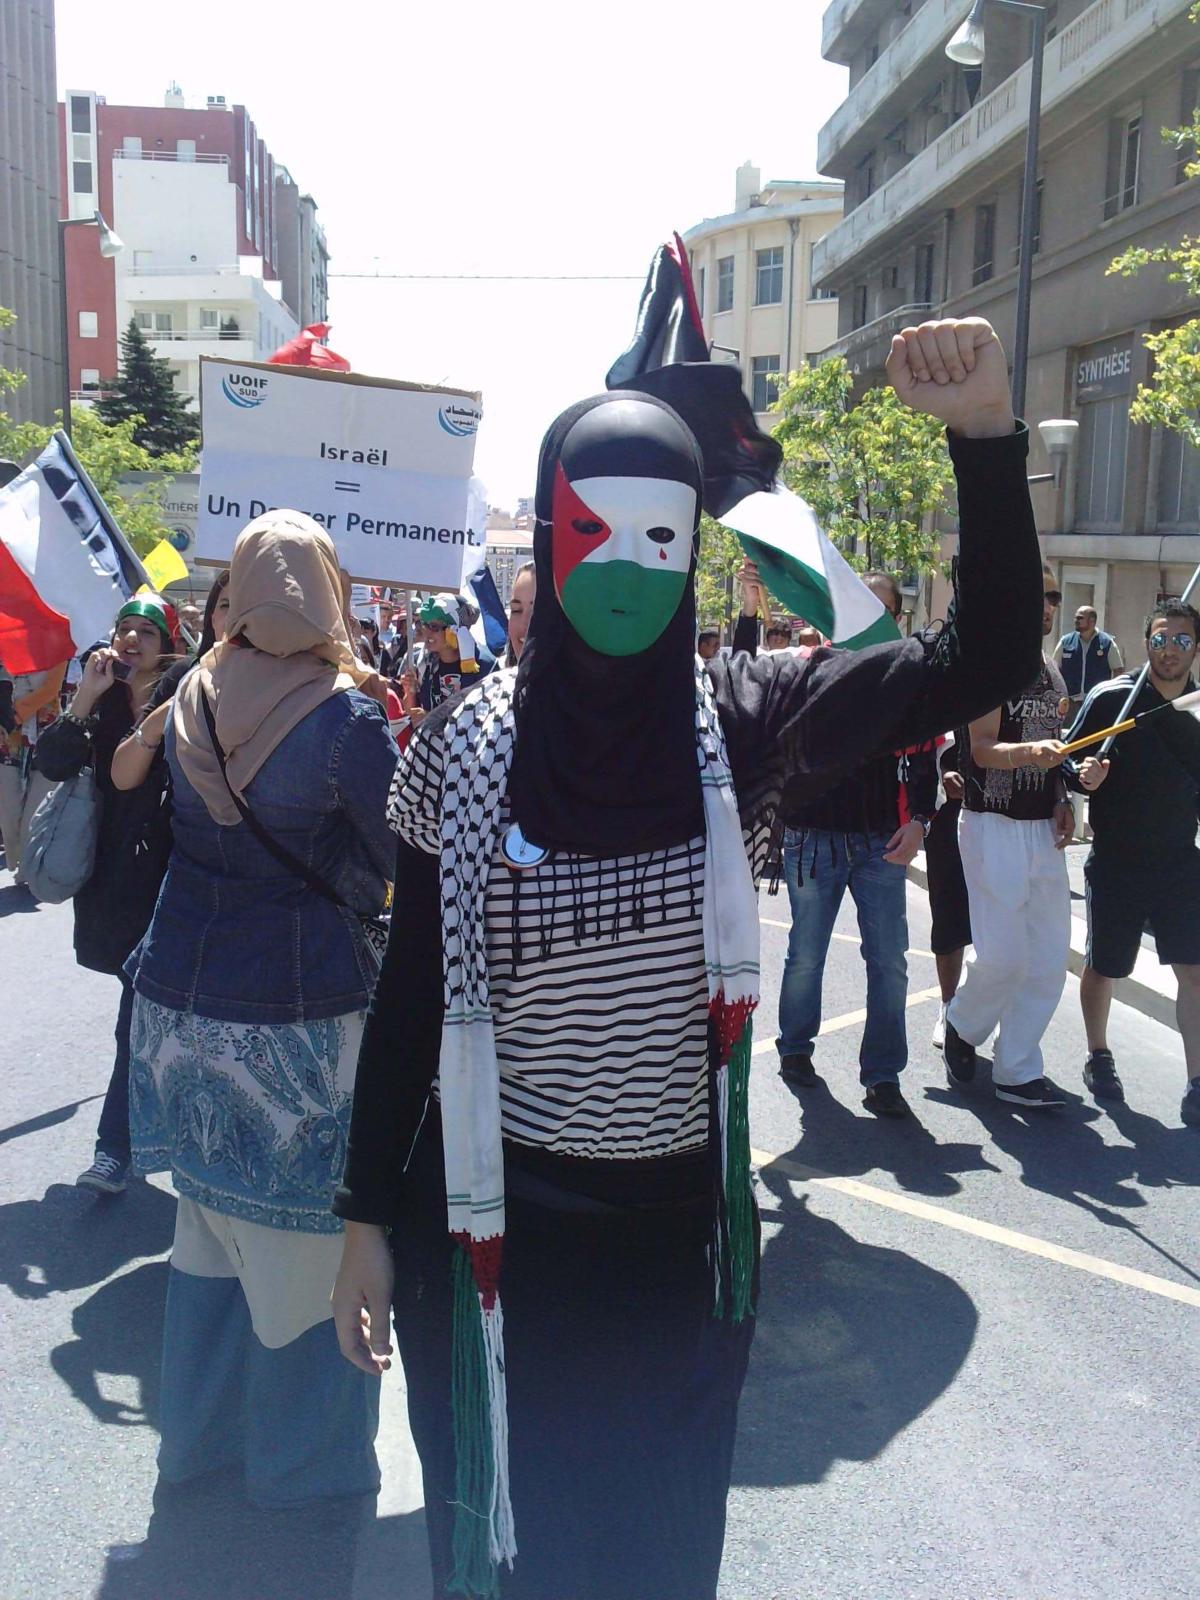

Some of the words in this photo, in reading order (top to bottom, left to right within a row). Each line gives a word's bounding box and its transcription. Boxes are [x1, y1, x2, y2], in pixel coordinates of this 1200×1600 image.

[1078, 347, 1131, 384] SYNTHÈSE
[229, 373, 268, 389] UOIF
[239, 388, 258, 397] SUD
[320, 442, 387, 466] Israël
[334, 480, 361, 493] =
[207, 494, 240, 518] Un
[249, 500, 337, 529] Der
[346, 512, 481, 547] Permanent.
